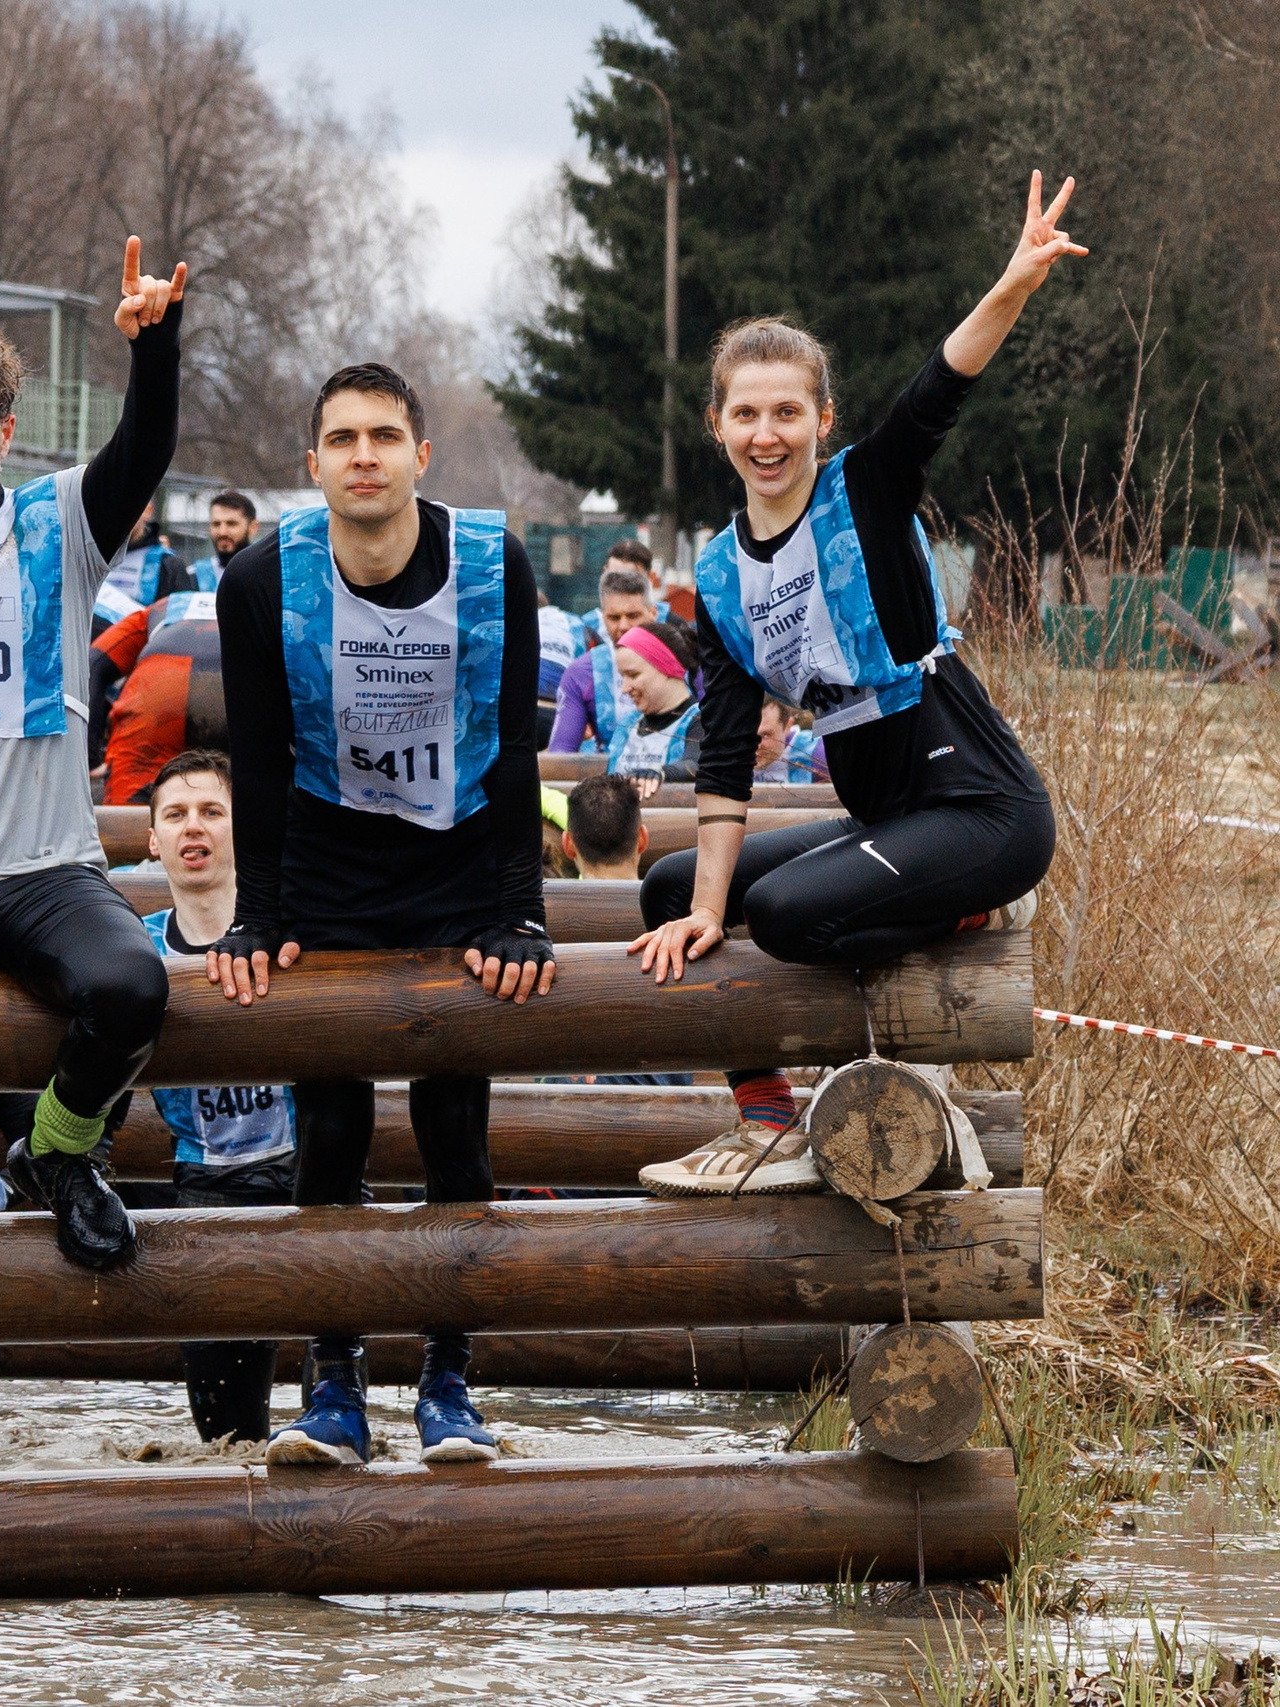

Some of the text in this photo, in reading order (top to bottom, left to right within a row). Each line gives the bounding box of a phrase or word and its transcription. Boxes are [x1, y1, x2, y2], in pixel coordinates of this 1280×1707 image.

[748, 601, 770, 618] ГОН
[762, 604, 809, 641] mine
[340, 640, 451, 655] ГОНКА ГЕРОЕВ
[355, 664, 434, 684] Sminex
[355, 691, 434, 700] ПЕРФЕКЦИОНИСТЫ
[355, 699, 433, 709] FINE DEVELOPMENT
[350, 742, 439, 783] 5411
[197, 1086, 274, 1122] 5408
